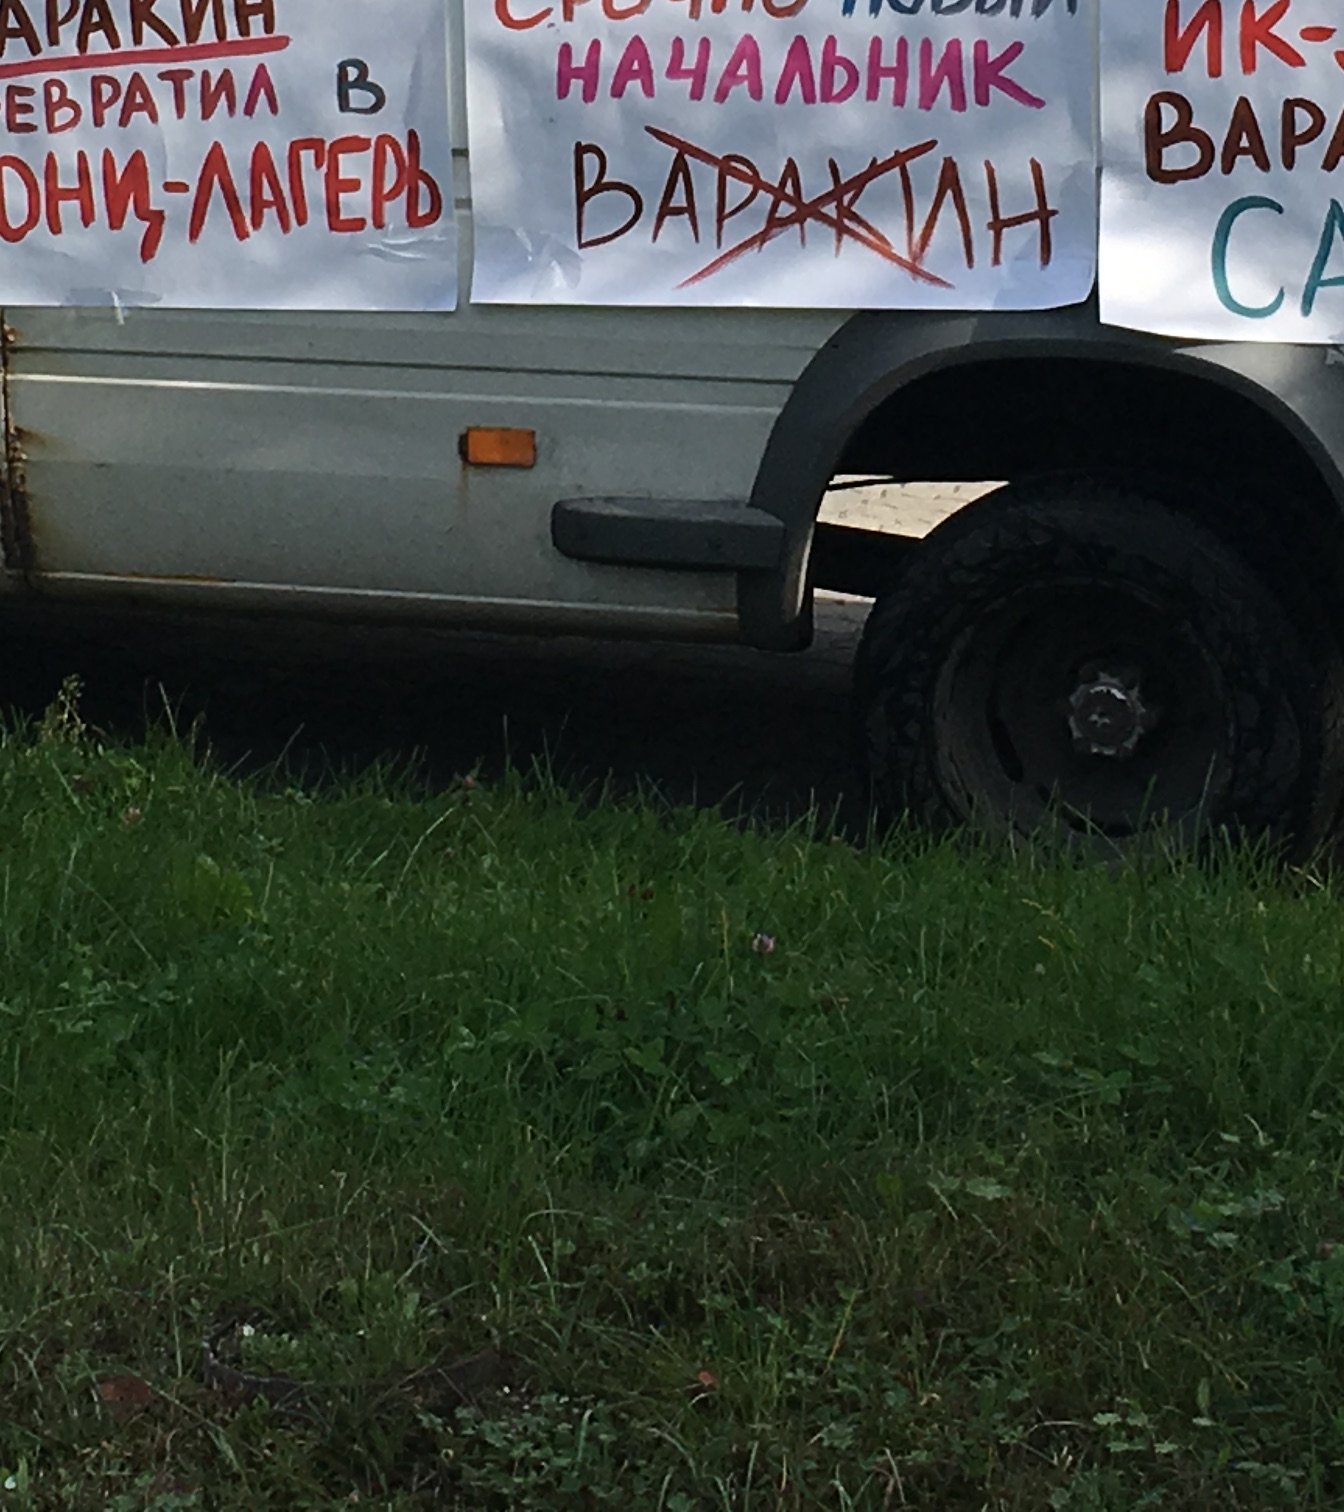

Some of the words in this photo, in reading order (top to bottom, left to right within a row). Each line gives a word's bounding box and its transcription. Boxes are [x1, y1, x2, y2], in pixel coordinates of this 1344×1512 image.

[336, 58, 387, 115] В
[555, 33, 1047, 112] НАЧАЛЬНИК
[574, 140, 1060, 269] ВАРАКИН
